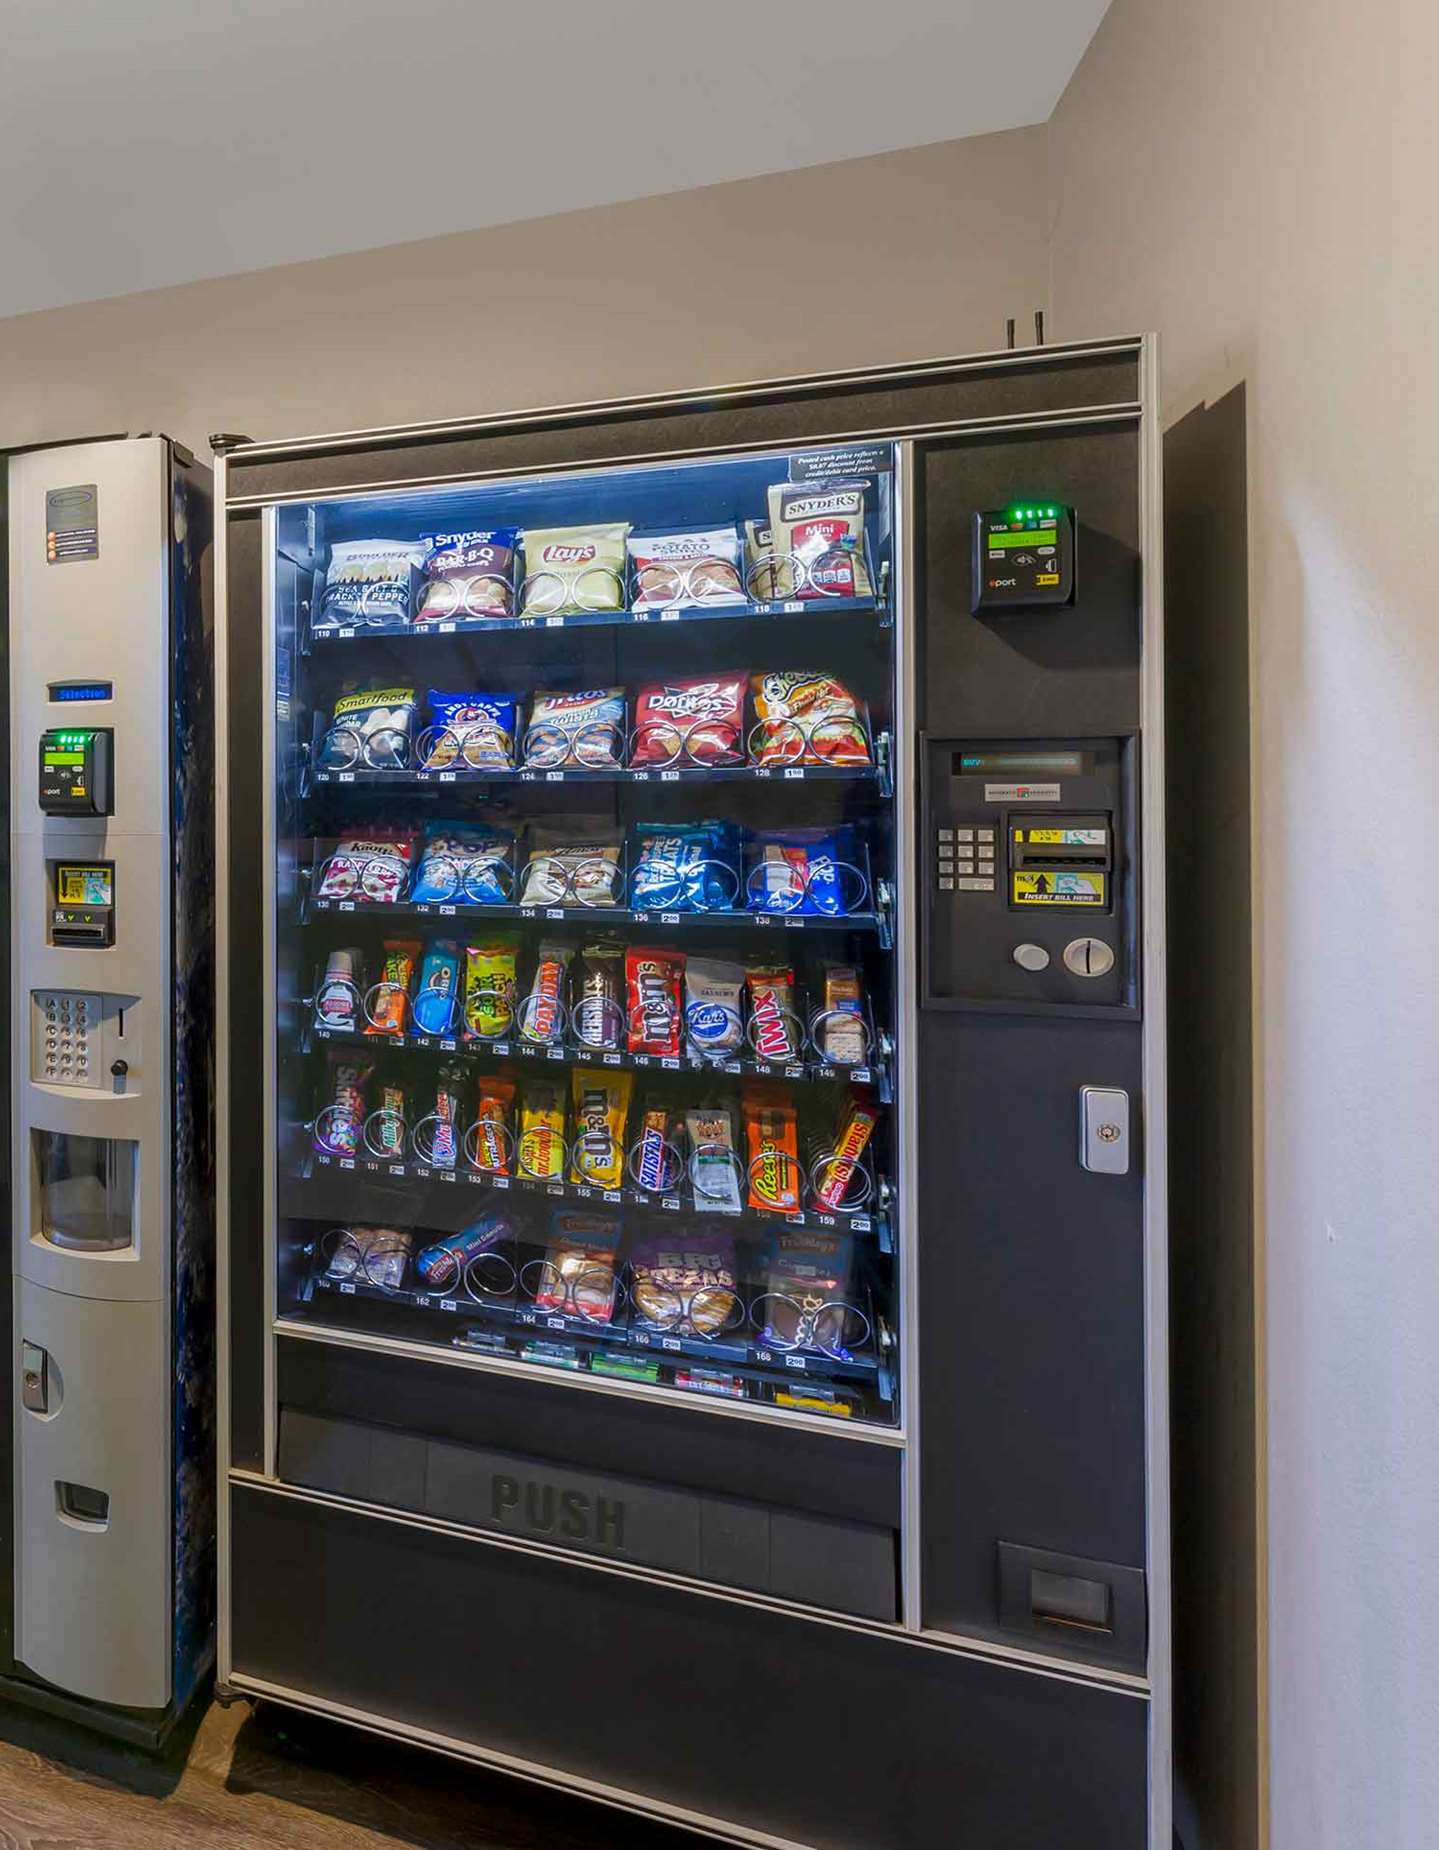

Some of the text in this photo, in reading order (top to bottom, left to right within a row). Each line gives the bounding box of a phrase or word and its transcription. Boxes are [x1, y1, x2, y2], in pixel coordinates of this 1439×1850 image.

[788, 494, 856, 515] SNYDER'S
[805, 523, 834, 537] Mini
[434, 531, 497, 550] Snyder
[338, 691, 408, 711] Smartfood
[444, 701, 470, 717] ANDY
[1024, 892, 1054, 901] INSERT
[754, 990, 789, 1056] TWIX
[755, 1141, 777, 1200] Reese's
[820, 1217, 835, 1225] 159
[491, 1473, 626, 1550] PUSH
